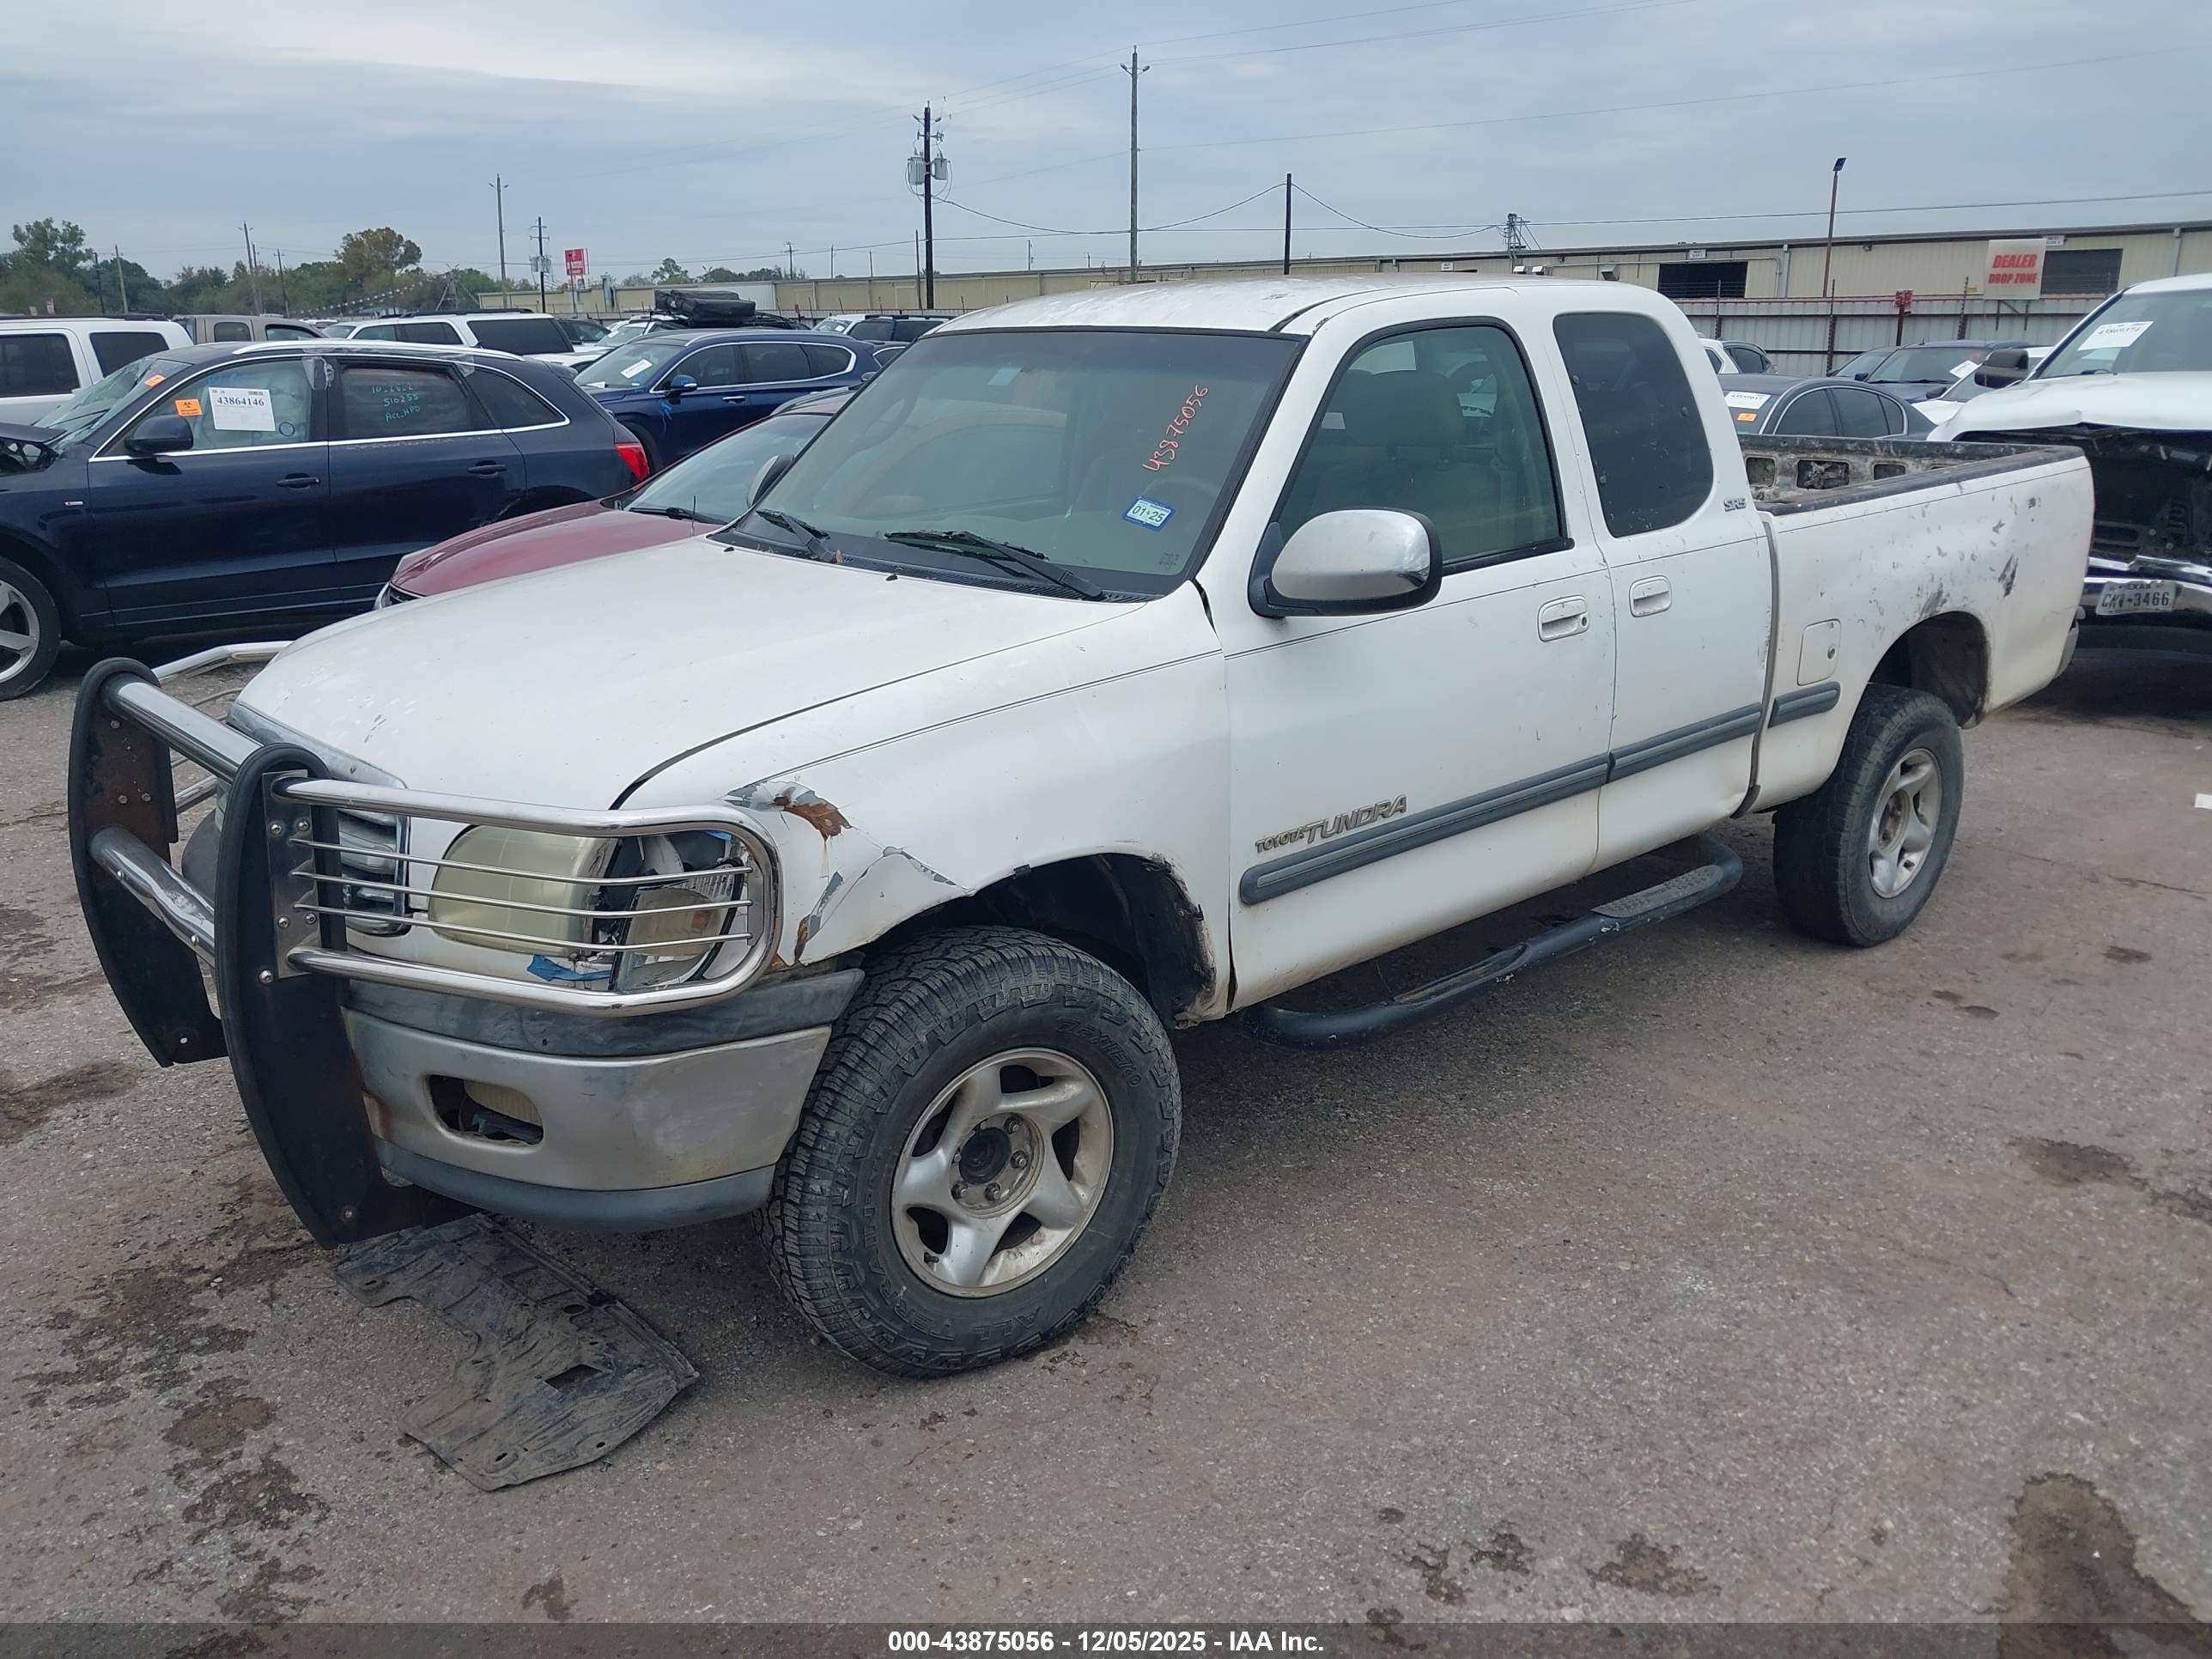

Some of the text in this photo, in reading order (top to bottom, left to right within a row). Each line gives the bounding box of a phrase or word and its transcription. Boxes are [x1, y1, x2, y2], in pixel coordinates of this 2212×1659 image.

[1992, 254, 2038, 268] DEALER
[1988, 273, 2039, 283] DROP ZONE
[217, 396, 264, 406] 43864146
[1142, 384, 1208, 471] 43875056
[1132, 505, 1165, 523] 01 25
[1255, 794, 1407, 853] TOYOTA TUNDRA
[972, 1305, 1042, 1340] ALL
